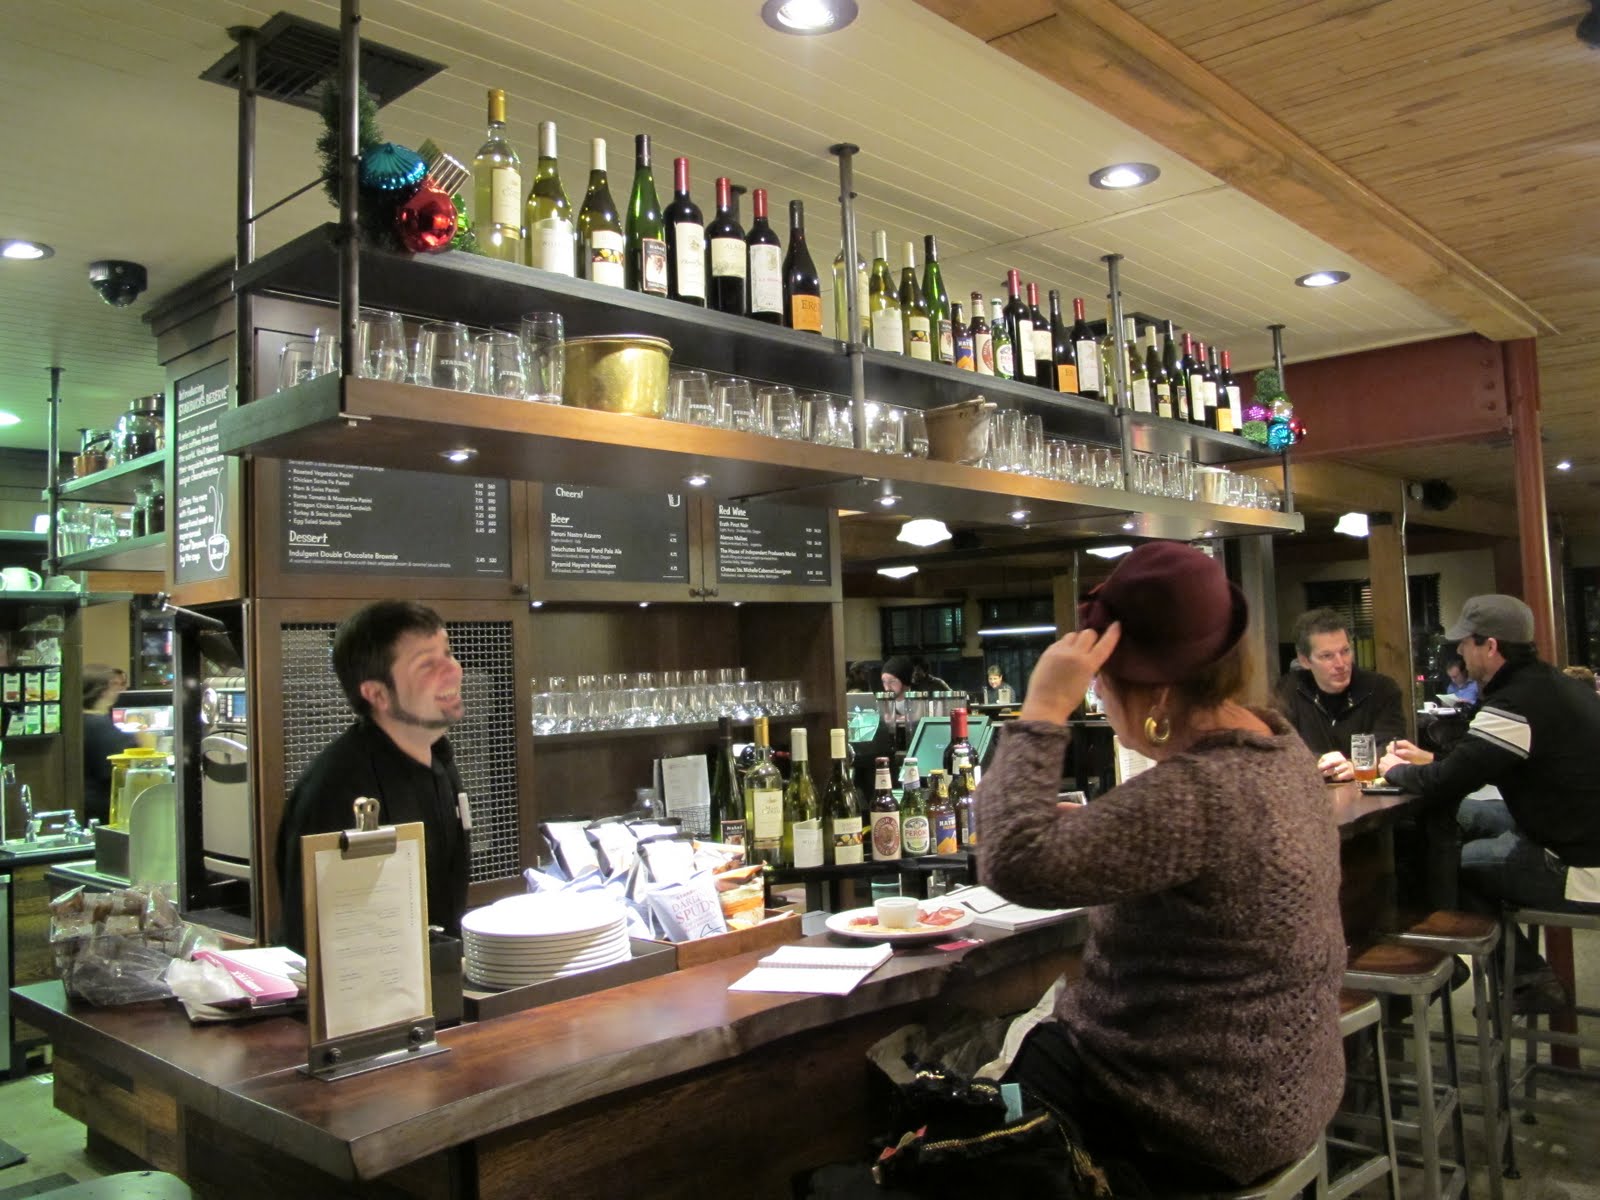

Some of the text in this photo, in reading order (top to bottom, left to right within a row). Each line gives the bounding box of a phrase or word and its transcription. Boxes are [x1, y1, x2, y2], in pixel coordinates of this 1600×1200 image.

[556, 487, 583, 499] Cheers!
[719, 505, 746, 517] Red Wine
[551, 513, 570, 523] Beer
[289, 530, 328, 543] Dessert
[289, 550, 319, 558] Indulgent
[344, 551, 374, 559] Chocolate
